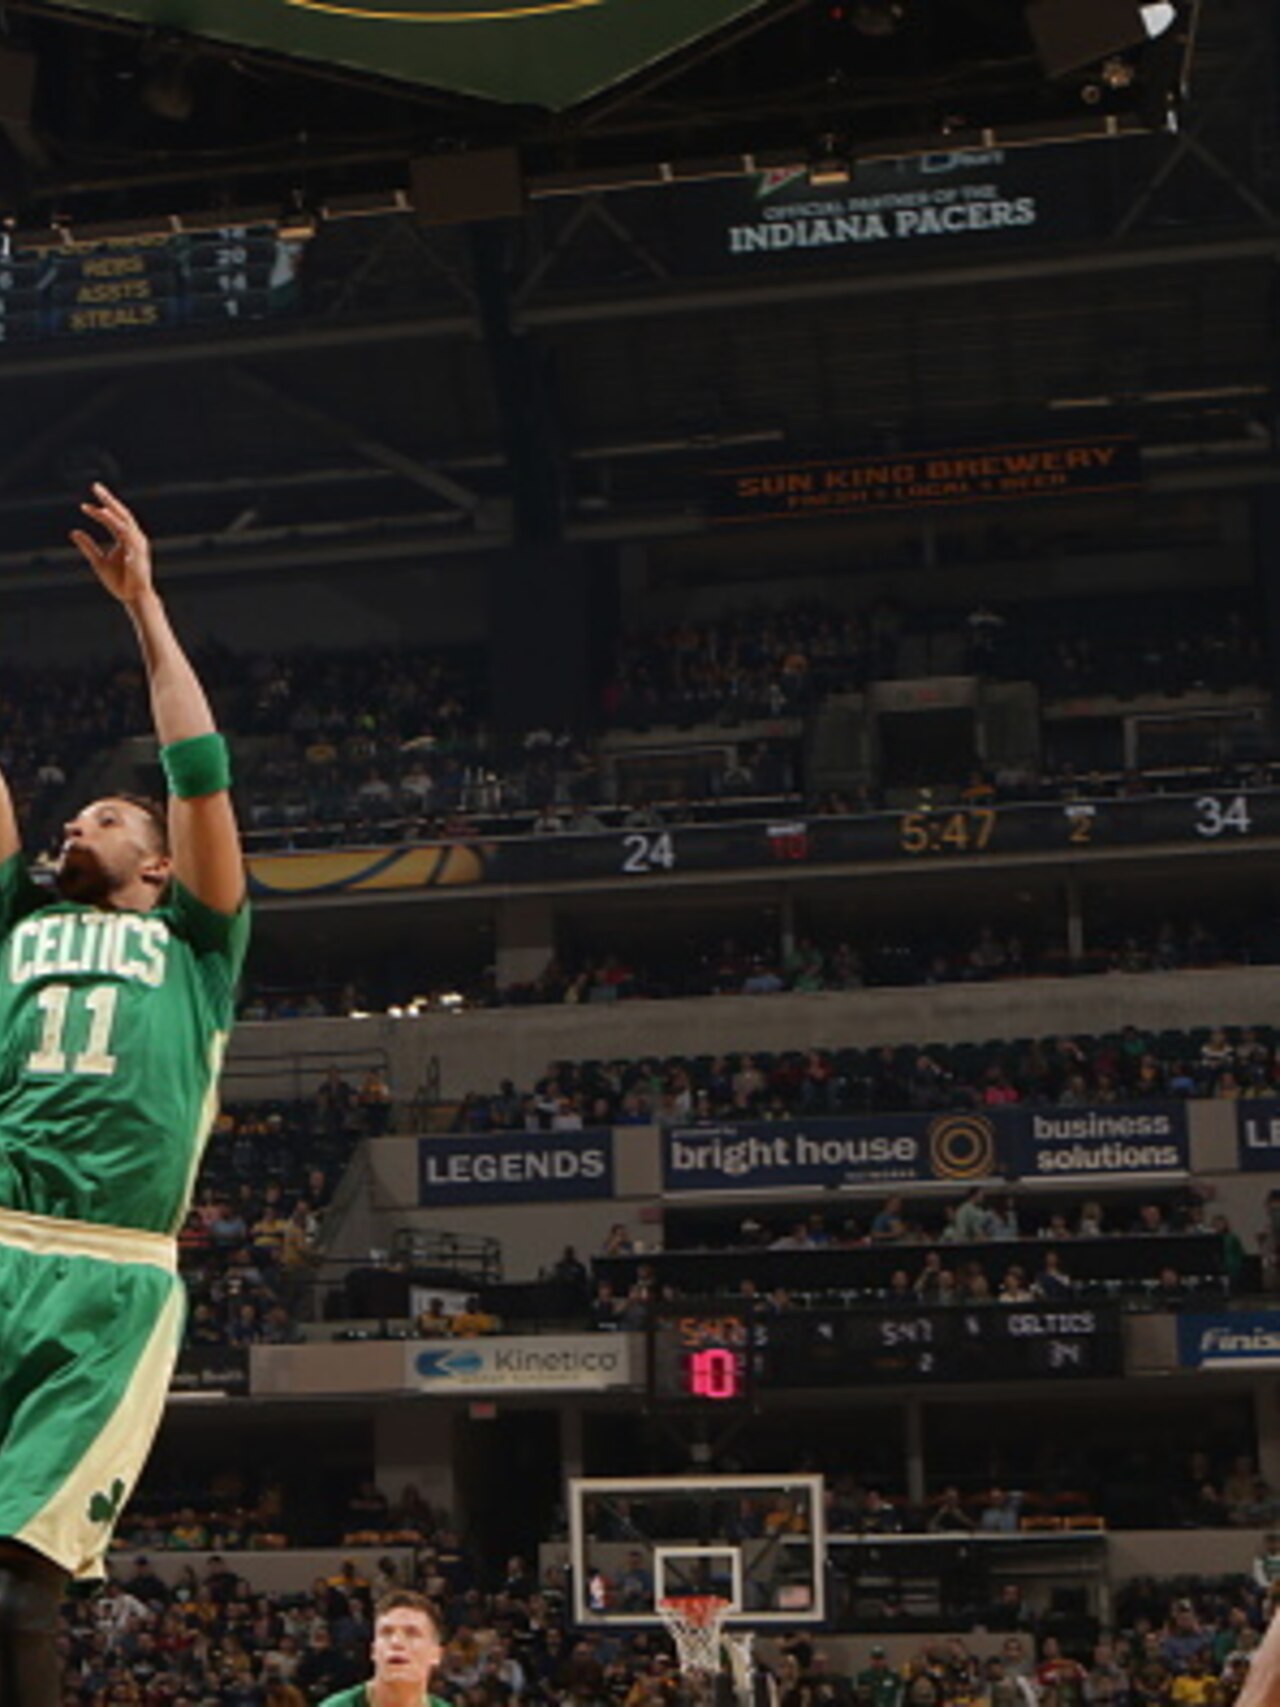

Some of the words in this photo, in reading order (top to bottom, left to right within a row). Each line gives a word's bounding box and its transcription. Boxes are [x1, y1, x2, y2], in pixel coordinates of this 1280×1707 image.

[728, 211, 890, 254] INDIANA
[894, 196, 1037, 238] PACERS
[737, 474, 813, 498] SUN
[824, 463, 916, 489] KING
[927, 447, 1114, 482] BREWERY
[900, 810, 996, 854] 5:47
[1070, 816, 1091, 843] 2
[1194, 796, 1252, 837] 34
[622, 832, 674, 873] 24
[9, 911, 170, 988] CELTICS
[26, 985, 118, 1075] 11
[1032, 1111, 1171, 1141] business
[426, 1148, 606, 1185] LEGENDS
[671, 1135, 793, 1177] bright
[796, 1131, 919, 1166] house
[1037, 1142, 1180, 1171] solutions
[1007, 1312, 1096, 1336] CELTICS
[495, 1349, 618, 1373] Kinetico
[691, 1348, 735, 1398] 10
